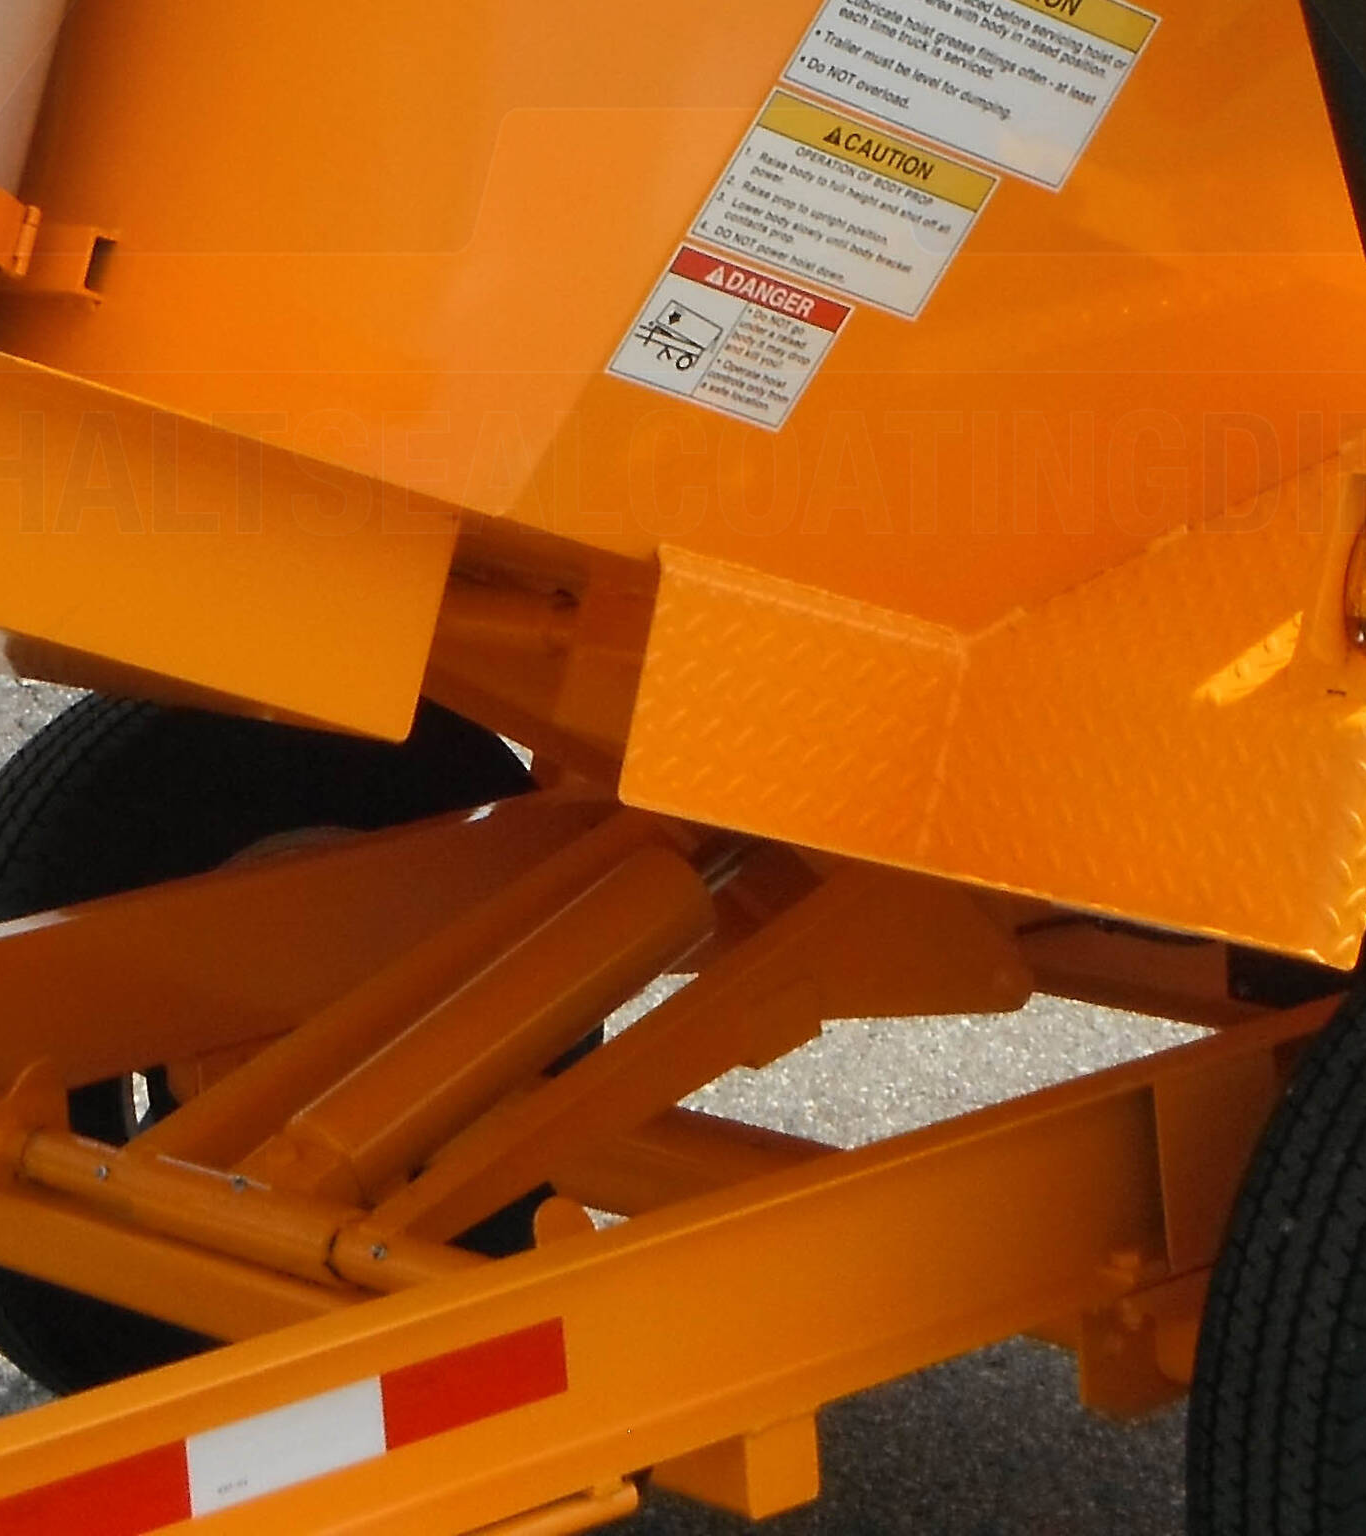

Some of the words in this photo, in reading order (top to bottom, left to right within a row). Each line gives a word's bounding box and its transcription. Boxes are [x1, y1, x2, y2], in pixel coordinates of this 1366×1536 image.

[838, 6, 869, 25] each
[869, 18, 897, 38] time
[897, 29, 928, 52] truck
[930, 42, 942, 57] is
[953, 5, 979, 23] with
[979, 16, 1009, 39] body
[1009, 31, 1023, 42] in
[1023, 36, 1060, 58] raised
[992, 5, 1031, 29] before
[1031, 23, 1083, 54] servicing
[1083, 44, 1113, 65] hoist
[1112, 58, 1127, 69] or
[806, 56, 826, 73] Do
[826, 65, 856, 84] NOT
[855, 79, 909, 109] overload.
[824, 30, 862, 54] Trailer
[862, 49, 895, 69] must
[893, 61, 911, 76] be
[911, 68, 942, 88] level
[941, 80, 960, 96] for
[903, 16, 935, 38] hoist
[933, 31, 976, 55] grease
[976, 47, 1017, 72] fittings
[1017, 66, 1047, 84] often
[1054, 82, 1068, 93] at
[1069, 86, 1096, 104] least
[794, 146, 855, 177] OPERATION
[856, 170, 873, 181] OF
[872, 176, 902, 194] BODY
[903, 188, 933, 204] PROP
[844, 132, 934, 180] CAUTION
[742, 180, 771, 199] Raise
[770, 194, 796, 210] prop
[797, 202, 809, 214] to
[809, 209, 847, 228] upright
[759, 152, 788, 170] Raise
[788, 164, 815, 182] body
[816, 175, 827, 186] to
[829, 179, 846, 192] full
[847, 187, 879, 206] height
[878, 201, 899, 214] and
[899, 209, 922, 223] shut
[713, 225, 732, 239] DO
[733, 232, 757, 246] NOT
[755, 244, 788, 259] power
[790, 254, 816, 270] hoist
[723, 211, 768, 233] contacts
[730, 198, 763, 216] Lower
[764, 210, 789, 228] body
[791, 222, 823, 241] slowly
[848, 243, 873, 259] body
[875, 253, 911, 272] bracket
[725, 271, 814, 316] DANGER
[752, 309, 767, 322] Do
[770, 315, 791, 327] NOT
